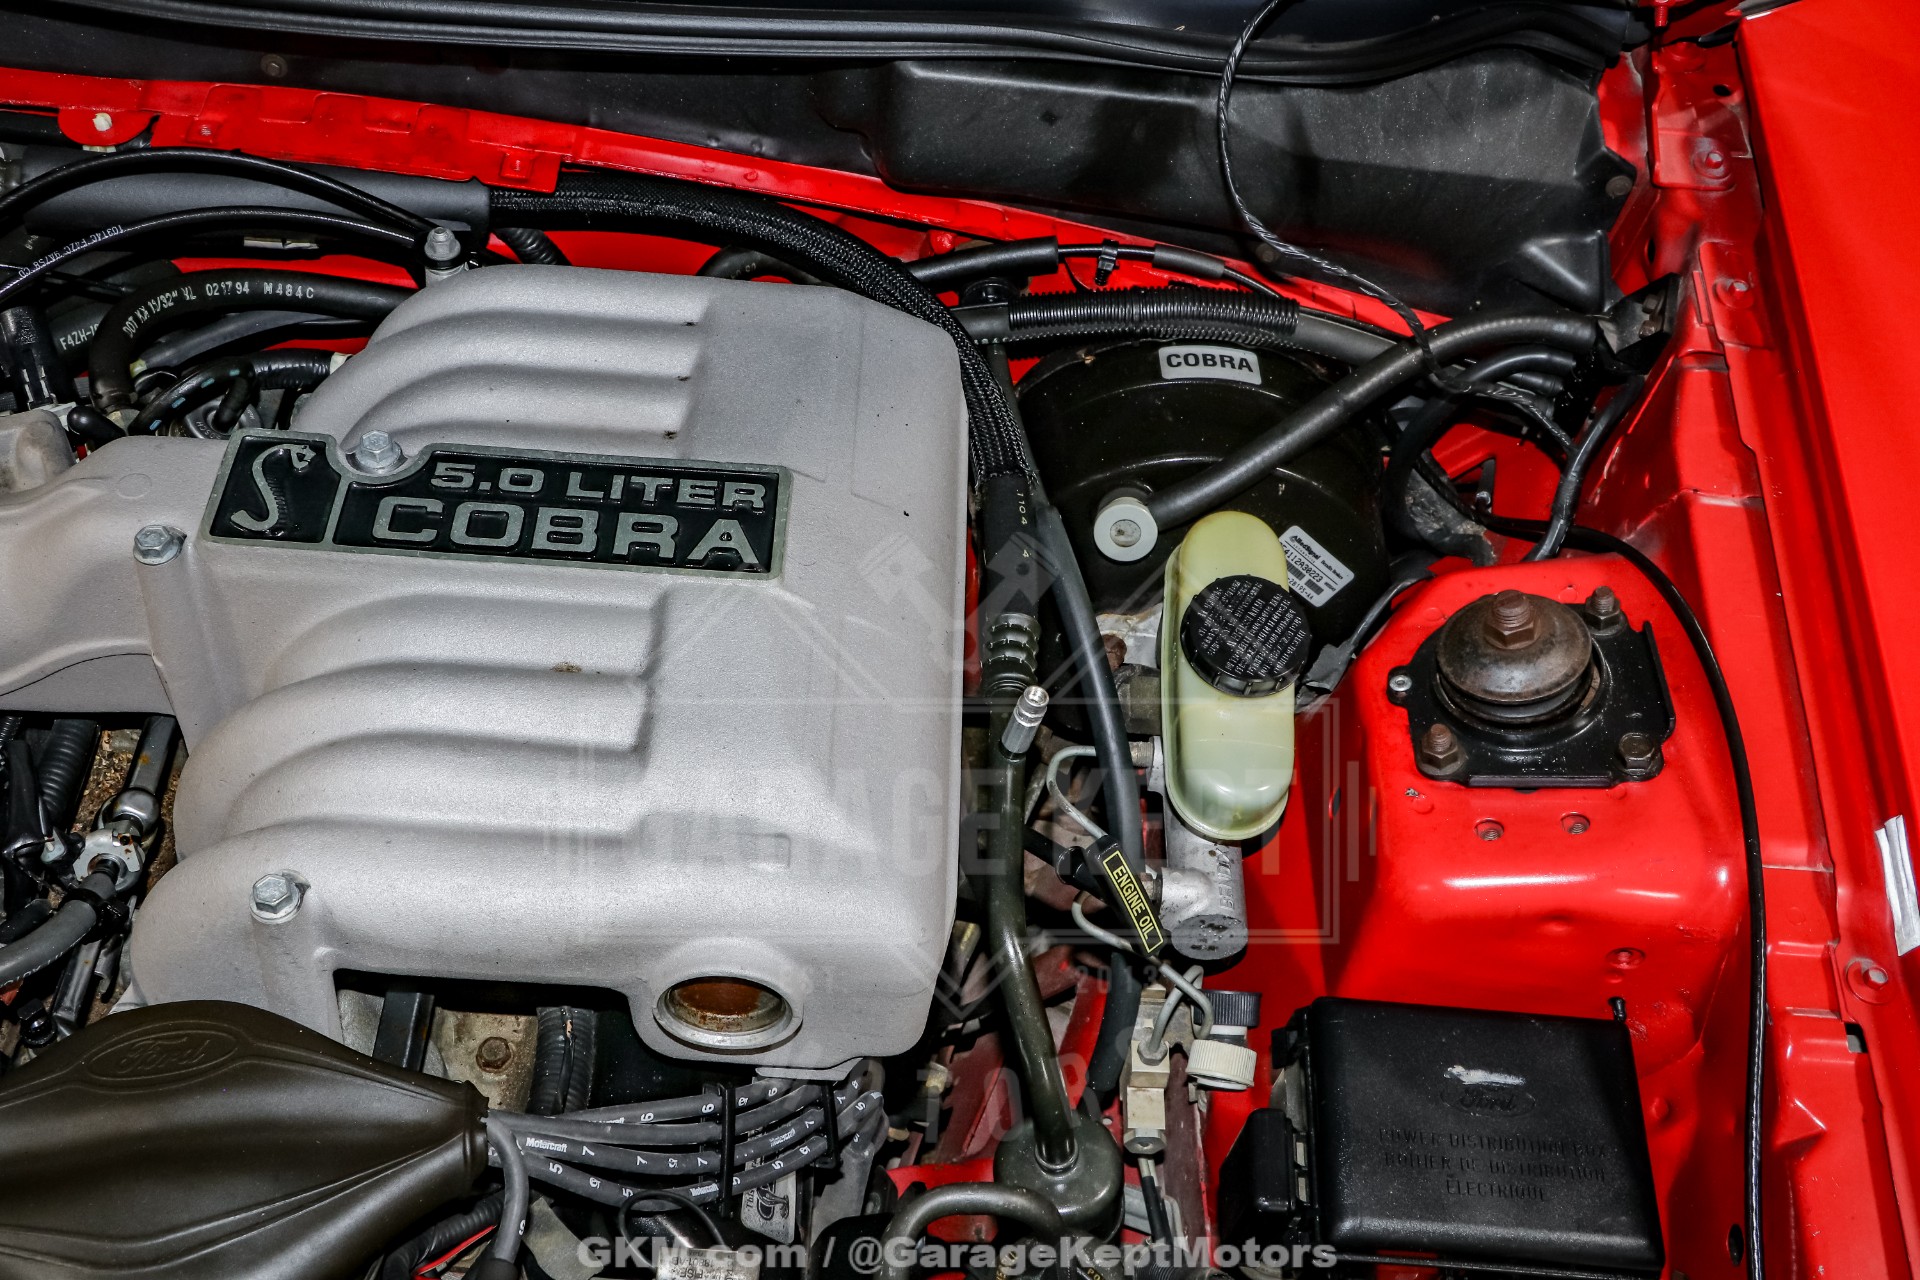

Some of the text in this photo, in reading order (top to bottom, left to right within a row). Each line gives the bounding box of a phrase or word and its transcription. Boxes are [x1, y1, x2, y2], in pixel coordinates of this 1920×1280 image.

[1166, 352, 1254, 373] COBRA
[430, 461, 767, 509] 5.0 LITER
[372, 496, 760, 565] COBRA
[1112, 864, 1157, 941] ENGINE OIL
[117, 1036, 211, 1074] Ford
[855, 1101, 866, 1111] 5
[804, 1120, 815, 1129] 7
[526, 1137, 568, 1153] Motorcraft
[582, 1145, 595, 1156] 7
[636, 1155, 648, 1165] 7
[697, 1157, 708, 1167] 7
[771, 1159, 784, 1170] 5
[549, 1162, 563, 1175] 5
[622, 1188, 634, 1198] 5
